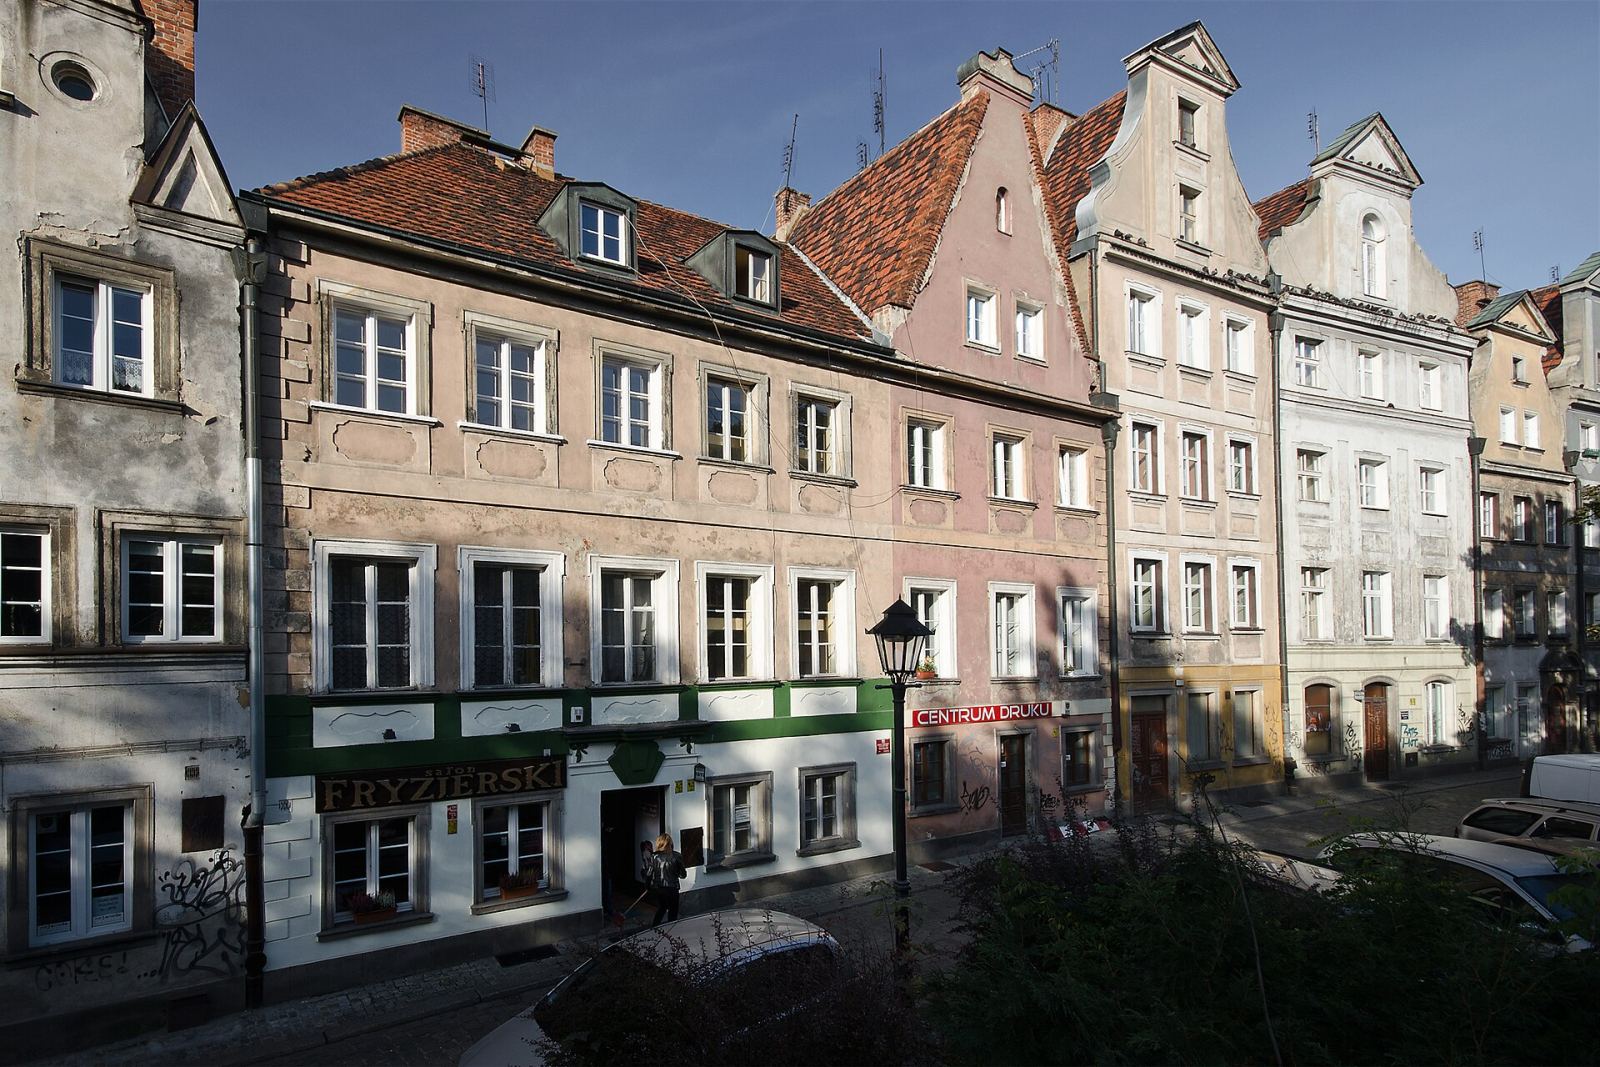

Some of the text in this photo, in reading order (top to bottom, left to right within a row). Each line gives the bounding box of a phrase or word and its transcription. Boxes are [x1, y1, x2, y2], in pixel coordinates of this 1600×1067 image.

[918, 703, 1050, 725] CENTRUM DRUKU
[425, 766, 476, 777] salon
[321, 760, 563, 810] FRYZJERSKI
